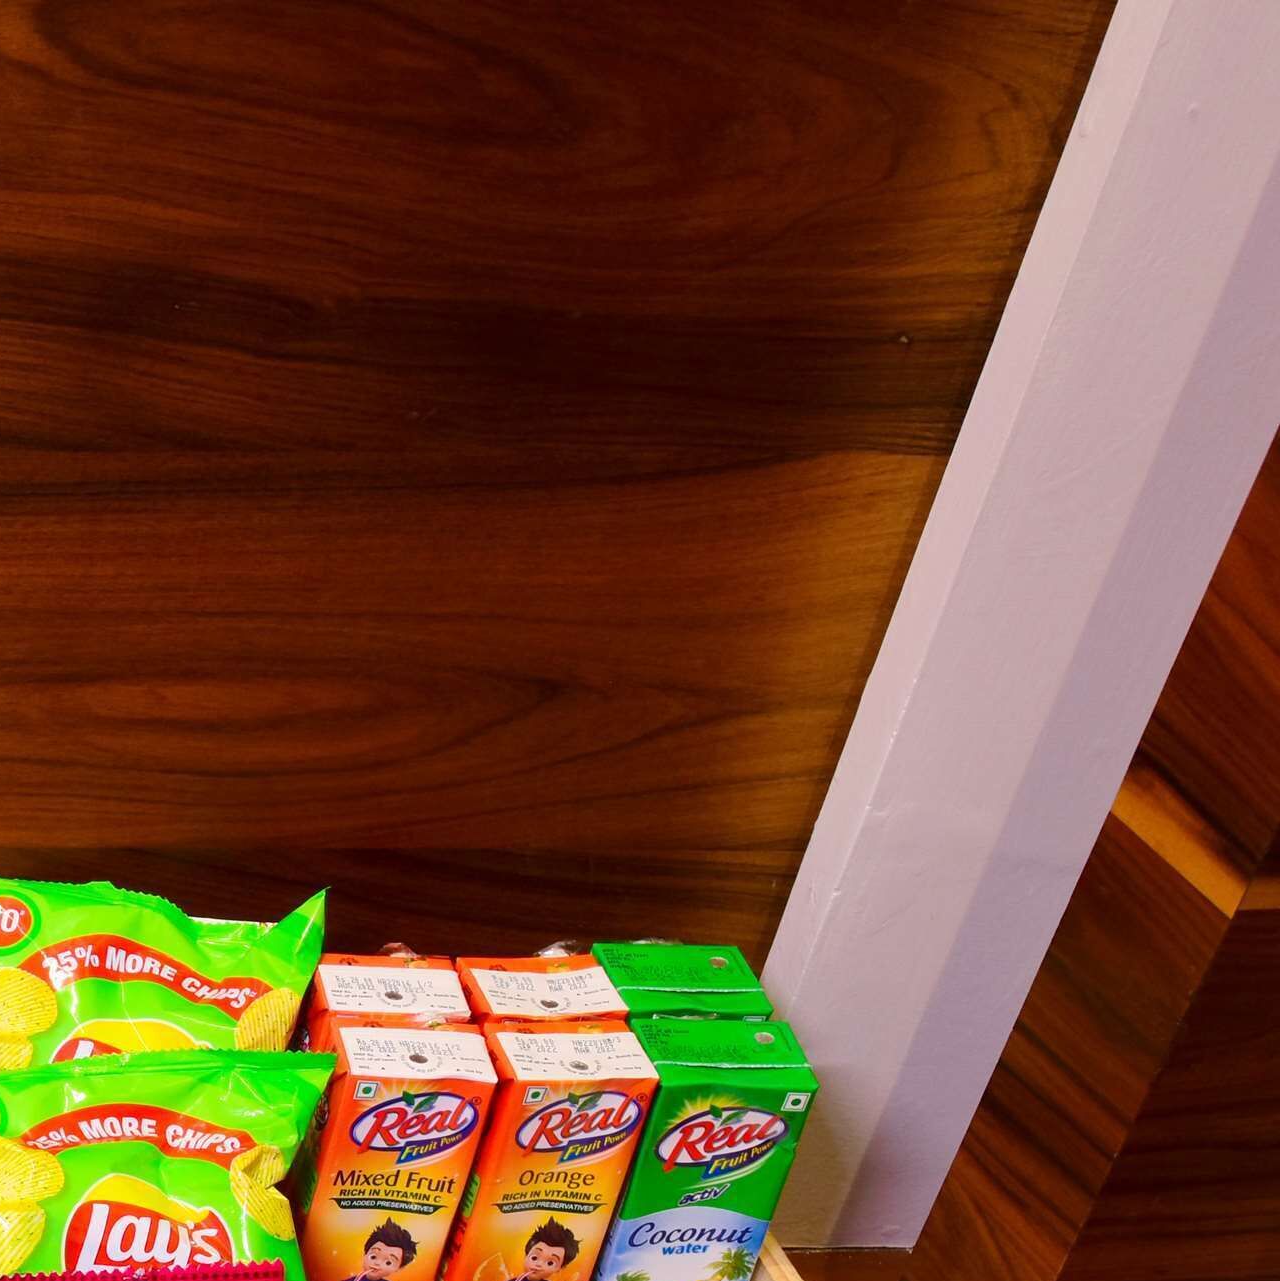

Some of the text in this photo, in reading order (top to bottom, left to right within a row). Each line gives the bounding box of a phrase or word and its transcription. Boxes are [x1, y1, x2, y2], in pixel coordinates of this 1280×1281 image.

[42, 944, 250, 1008] 25% MORE CHIPS
[78, 1116, 158, 1141] MORE
[165, 1123, 241, 1154] CHIPS
[356, 1100, 469, 1153] Real
[522, 1098, 632, 1157] Real
[399, 1137, 437, 1162] Fruit
[563, 1140, 600, 1161] Fruit
[662, 1115, 780, 1173] Real
[709, 1153, 748, 1174] Fruit
[332, 1169, 456, 1194] Mixed Fruit
[519, 1170, 595, 1189] Orange
[339, 1188, 442, 1203] RICH IN VITAMIN C
[354, 1200, 375, 1208] ADDED
[502, 1190, 602, 1202] RICH IN VITAMIN C
[502, 1201, 594, 1212] NO ADDED PRESERVATIVES
[76, 1202, 221, 1272] Lay's
[628, 1222, 753, 1248] Coconut
[662, 1242, 710, 1256] water
